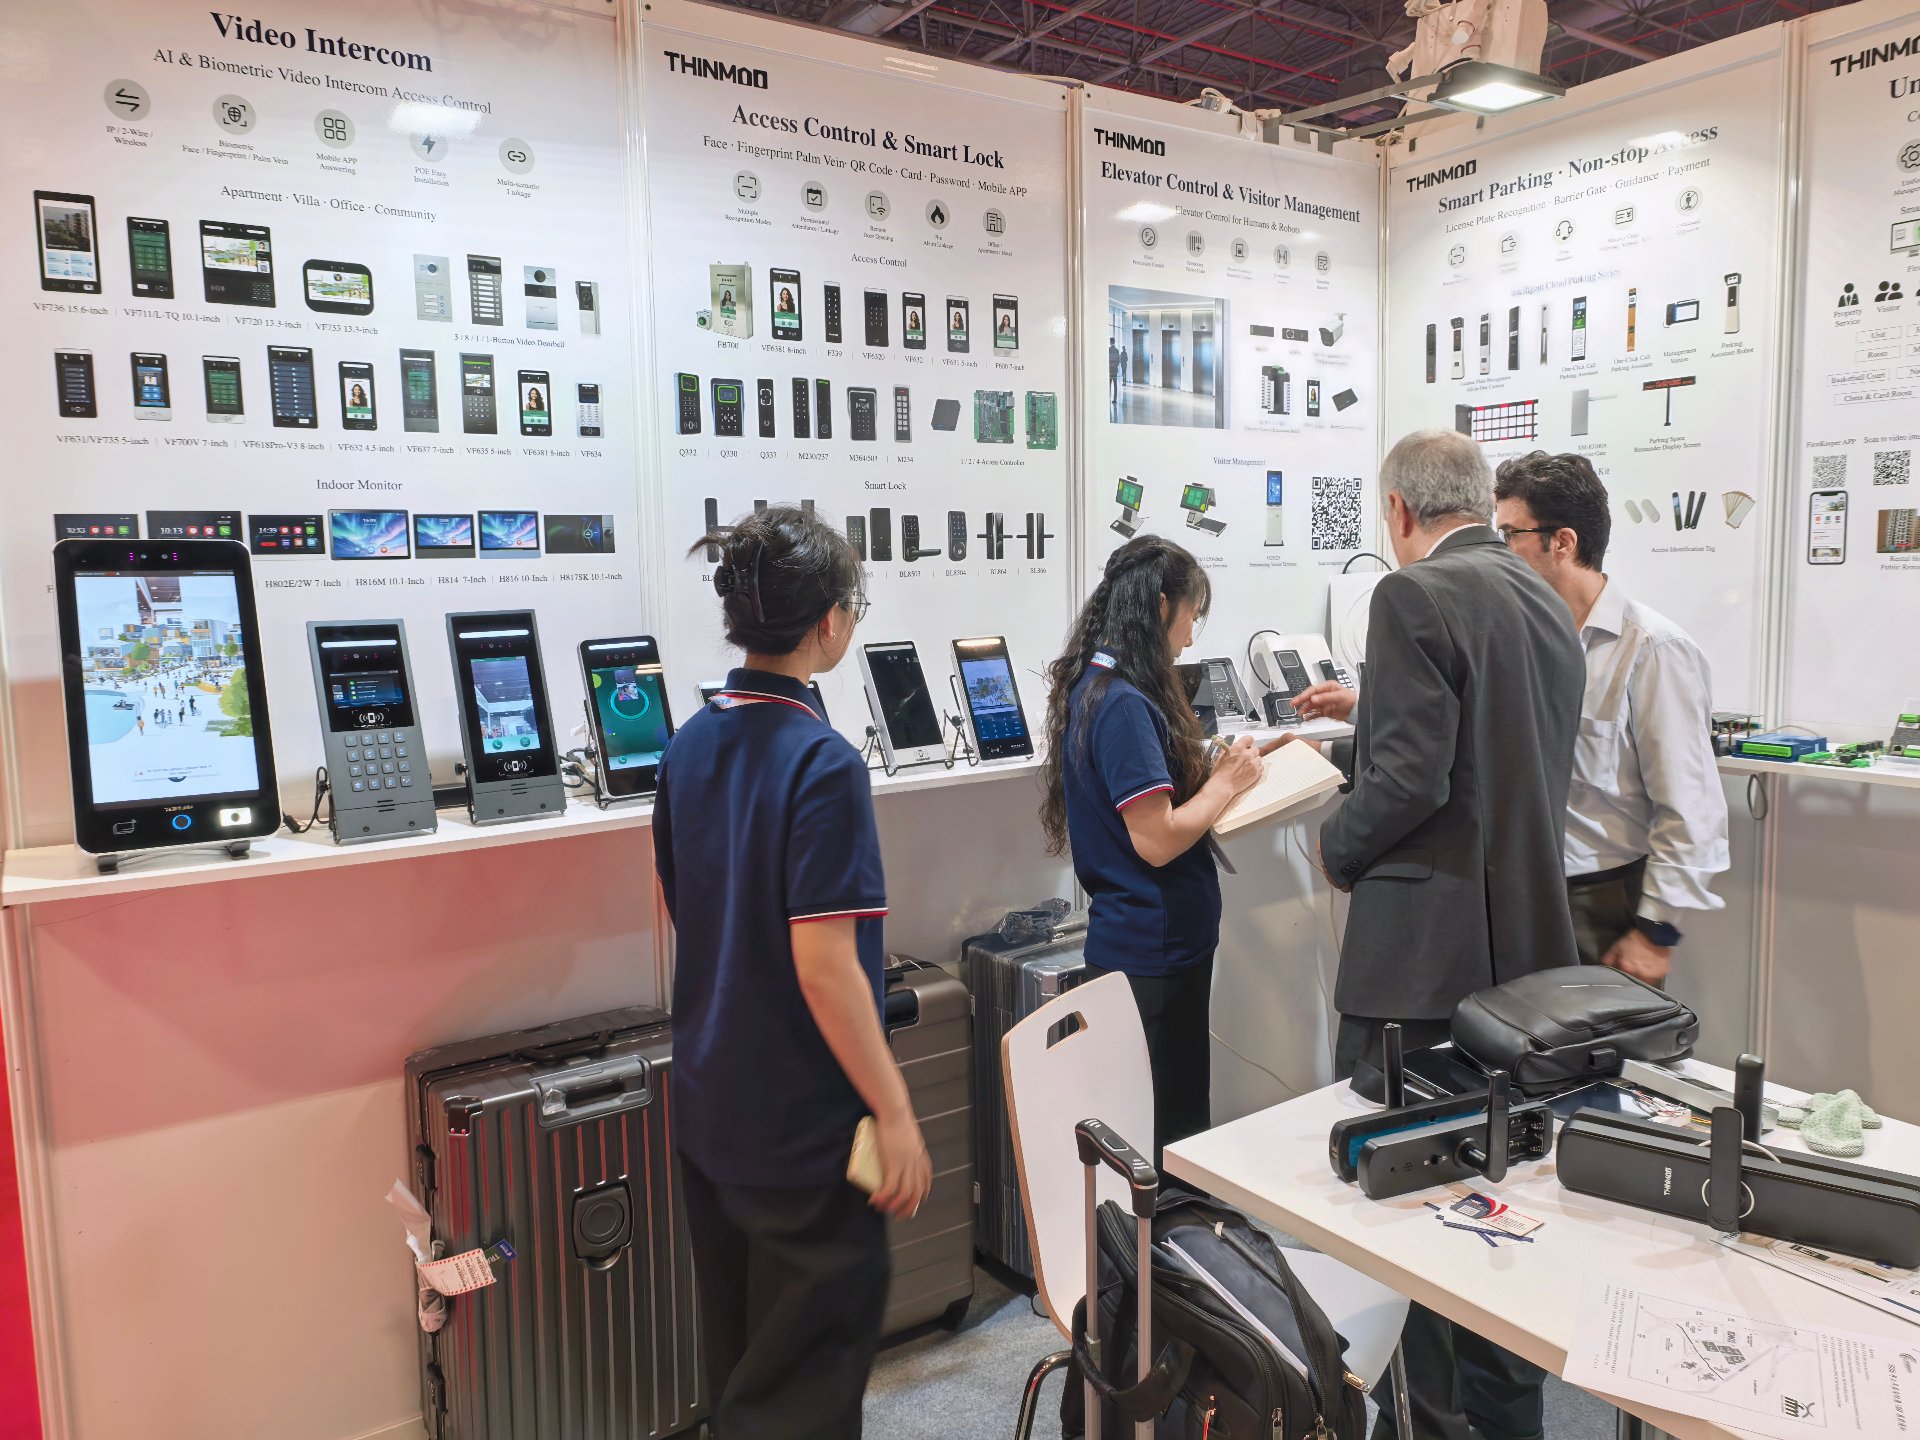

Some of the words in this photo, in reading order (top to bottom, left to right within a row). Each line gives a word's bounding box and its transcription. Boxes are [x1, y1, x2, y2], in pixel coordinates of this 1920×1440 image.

[209, 11, 296, 49] Video
[304, 27, 433, 72] Intercom
[153, 48, 174, 63] AI
[178, 52, 193, 67] &
[198, 54, 274, 79] Biometric
[277, 66, 321, 87] Video
[325, 75, 388, 98] Intercom
[391, 86, 439, 105] Access
[442, 94, 493, 115] Control
[121, 127, 149, 137] 2-Wire
[732, 103, 798, 134] Access
[803, 116, 876, 148] Control
[882, 131, 899, 151] &
[903, 134, 958, 162] Smart
[962, 144, 1005, 170] Lock
[114, 136, 148, 148] Wireless
[219, 140, 254, 151] Biometric
[182, 145, 200, 154] Face
[205, 147, 247, 160] Fingerprint
[252, 154, 271, 163] Palm
[273, 156, 289, 165] Vein
[316, 153, 341, 163] Mobile
[342, 155, 358, 164] APP
[319, 163, 357, 175] Answering
[703, 135, 728, 150] Face
[737, 140, 794, 161] Fingerprint
[795, 150, 822, 165] Palm
[823, 154, 845, 169] Vein
[849, 159, 867, 173] QR
[868, 162, 894, 177] Code
[900, 168, 923, 181] Card
[929, 172, 971, 189] Password
[977, 178, 1007, 194] Mobile
[1008, 185, 1028, 197] APP
[431, 169, 447, 178] Easy
[413, 176, 450, 187] Installation
[1438, 192, 1485, 214] Smart
[1488, 170, 1553, 202] Parking
[1567, 145, 1649, 178] Non-stop
[1101, 160, 1163, 188] Elevator
[1166, 173, 1218, 198] Control
[1222, 183, 1234, 200] &
[1238, 185, 1281, 208] Visitor
[1284, 194, 1361, 223] Management
[1445, 219, 1475, 234] License
[1476, 212, 1495, 225] Plate
[1497, 200, 1546, 221] Recognition
[1553, 191, 1584, 206] Barrier
[1585, 183, 1607, 197] Gate
[1614, 170, 1660, 190] Guidance
[1667, 158, 1711, 177] Payment
[220, 185, 283, 202] Apartment
[293, 193, 321, 207] Villa
[330, 198, 365, 212] Office
[374, 204, 437, 223] Community
[1175, 205, 1204, 219] Elevator
[1205, 210, 1231, 223] Control
[1232, 214, 1242, 225] for
[1243, 216, 1270, 230] Humans
[1271, 221, 1277, 230] &
[1278, 222, 1301, 235] Robots
[851, 253, 878, 267] Access
[878, 256, 908, 268] Control
[33, 303, 66, 313] VF736
[68, 305, 109, 316] 15.6-inch
[1833, 308, 1863, 318] Property
[1876, 304, 1901, 313] Visitor
[123, 309, 180, 321] VF711/L-TQ
[182, 311, 221, 323] 10.1-inch
[234, 316, 263, 326] VF720
[265, 318, 302, 329] 13.3-inch
[1834, 318, 1861, 328] Service
[343, 324, 379, 335] 13.3-inch
[1871, 331, 1886, 339] Unit
[454, 333, 460, 341] 3
[515, 338, 536, 346] Video
[1867, 351, 1888, 359] Room
[1891, 389, 1913, 398] Room
[121, 437, 150, 445] 5-inch
[164, 437, 200, 446] VF700V
[202, 438, 229, 448] 7-inch
[242, 440, 299, 450] VF618Pro-V3
[300, 441, 325, 451] 8-inch
[338, 444, 363, 452] VF632
[364, 444, 395, 453] 4.5-inch
[432, 446, 455, 454] 7-inch
[466, 447, 489, 455] VF635
[490, 448, 511, 456] 5-inch
[1213, 456, 1232, 466] Visitor
[1598, 467, 1610, 476] Kit
[316, 479, 355, 490] Indoor
[357, 479, 403, 491] Monitor
[864, 481, 887, 490] Smart
[888, 481, 907, 490] Lock
[355, 578, 387, 586] H816M
[388, 577, 425, 586] 10.1-Inch
[438, 576, 459, 584] H814
[463, 576, 487, 584] 7-Inch
[499, 575, 520, 583] H816
[521, 574, 548, 583] 10-Inch
